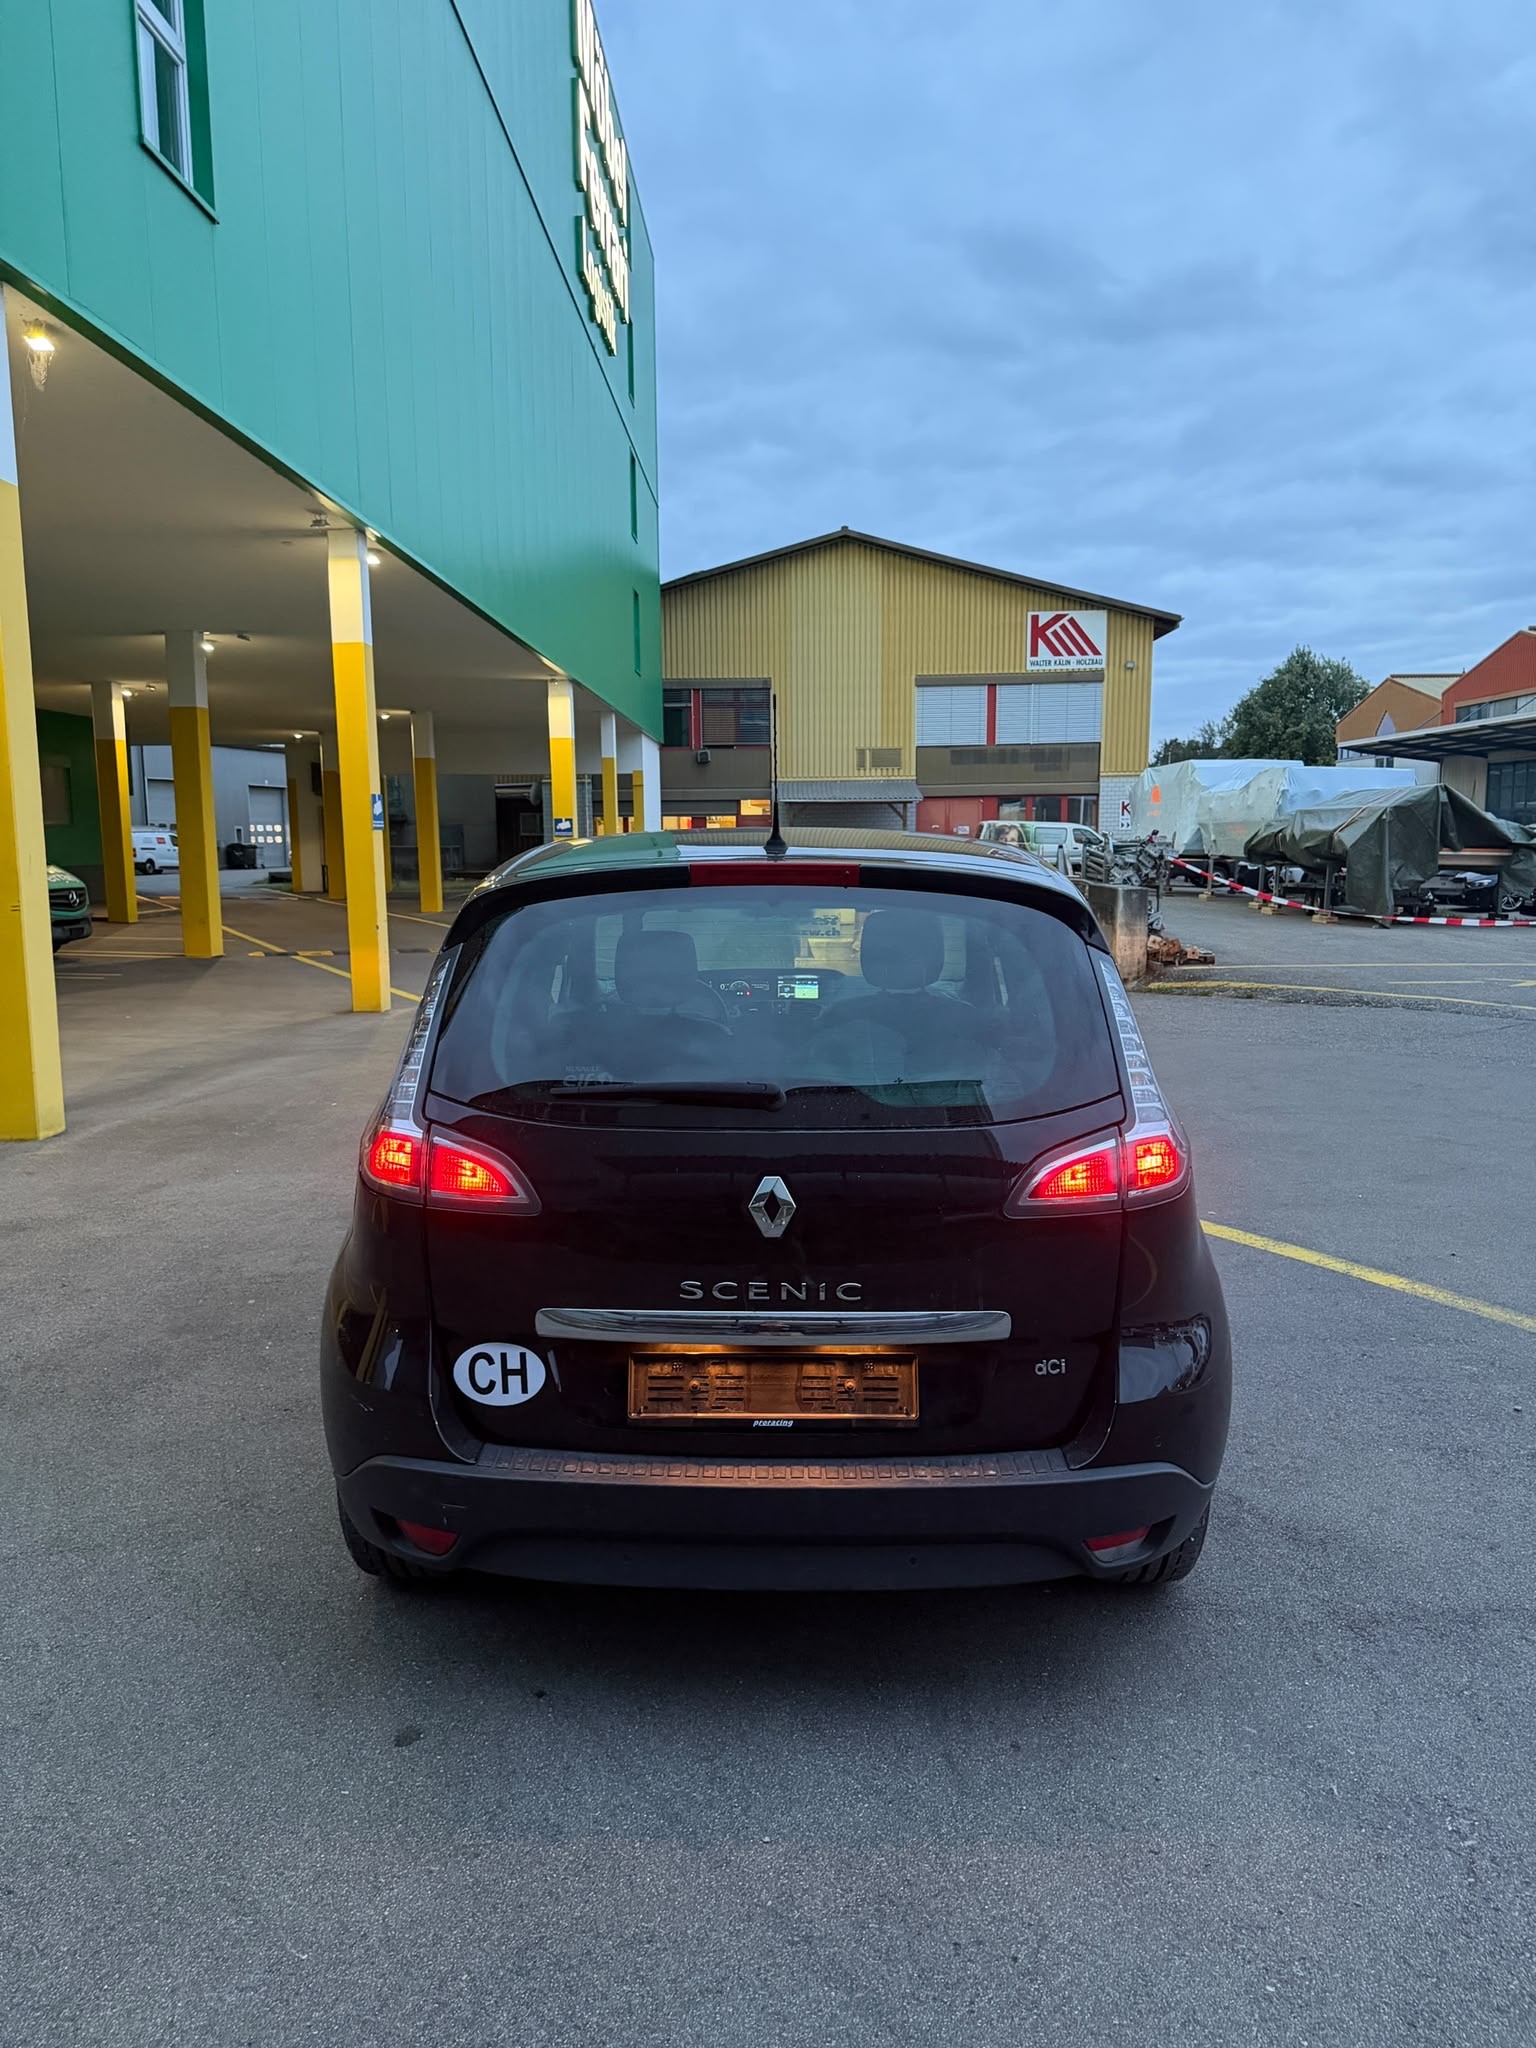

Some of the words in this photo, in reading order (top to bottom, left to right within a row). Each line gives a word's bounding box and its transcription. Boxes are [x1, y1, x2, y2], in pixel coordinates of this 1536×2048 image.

[576, 0, 627, 227] Möbel
[579, 78, 629, 324] Ferrari
[582, 216, 617, 356] Logistik
[680, 1281, 862, 1300] SCENIC
[468, 1351, 529, 1395] CH
[1035, 1359, 1066, 1375] dCi
